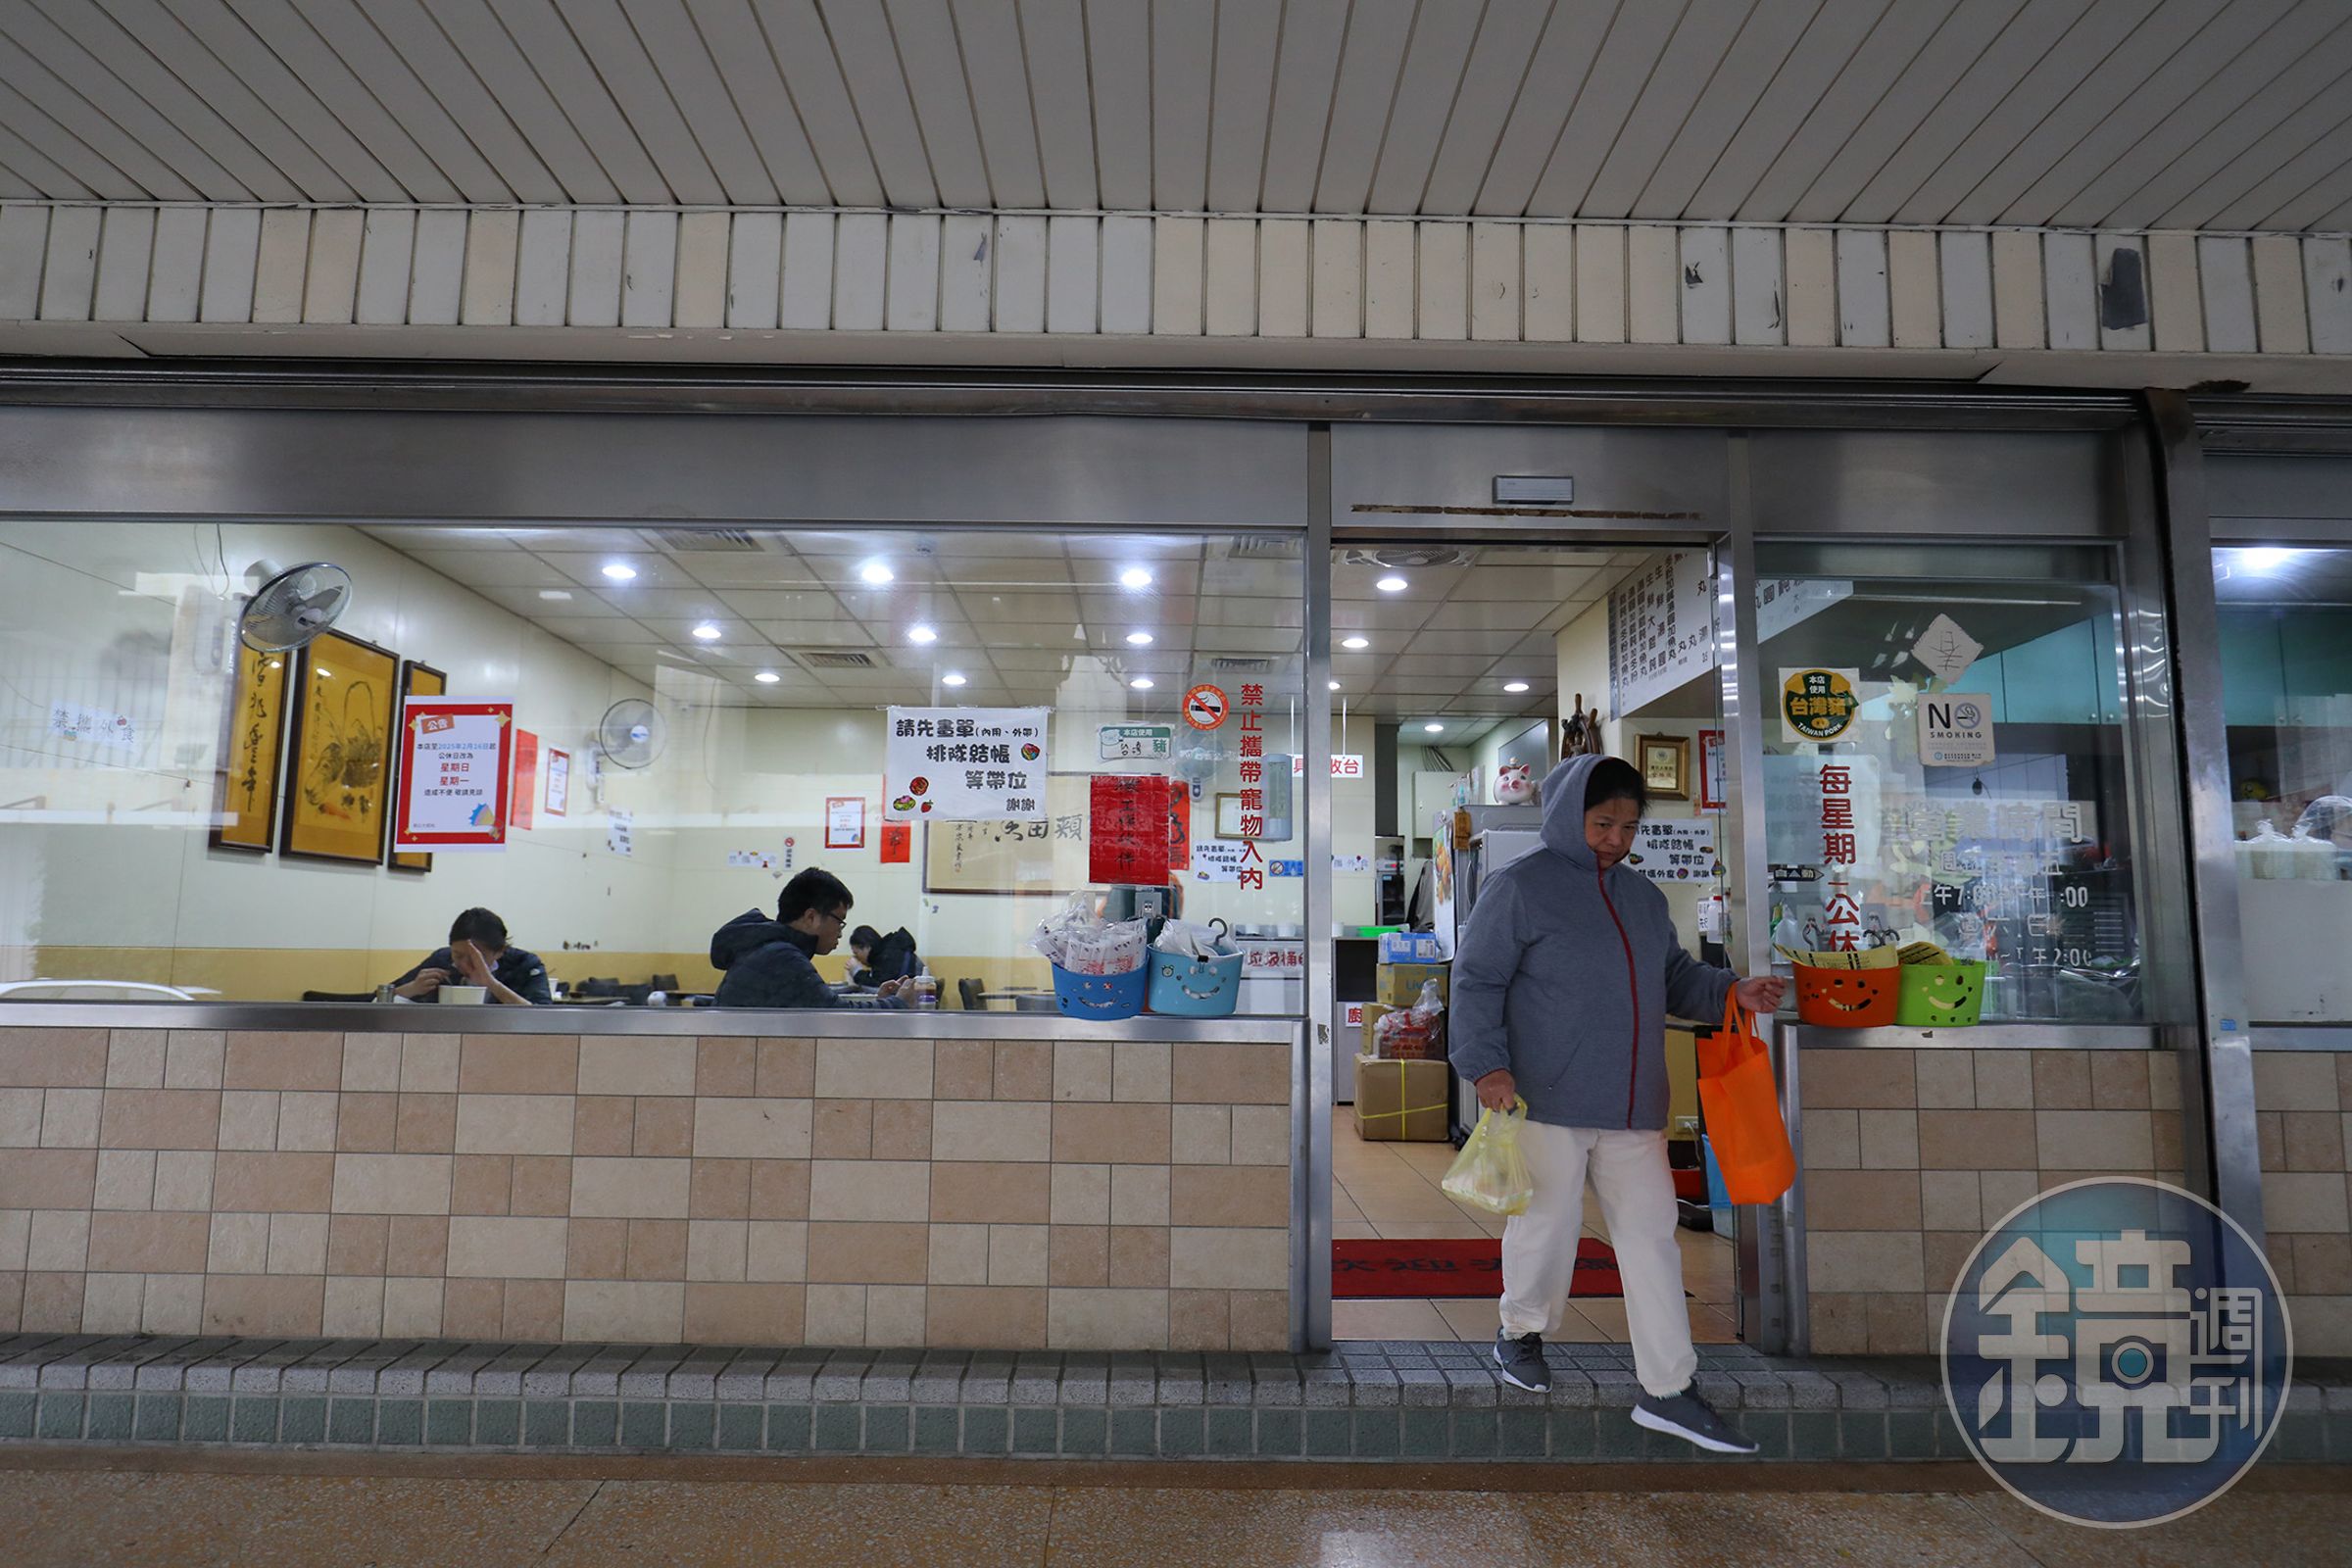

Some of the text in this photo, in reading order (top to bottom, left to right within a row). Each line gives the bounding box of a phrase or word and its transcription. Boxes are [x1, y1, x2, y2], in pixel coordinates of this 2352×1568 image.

[1809, 675, 1825, 684] 本店
[1809, 685, 1825, 694] 使用
[1123, 728, 1152, 737] 本店使用
[1797, 722, 1843, 737] TAIWAN PORK
[926, 744, 1010, 763] 排隊結帳
[439, 763, 469, 772] 星期日
[439, 776, 469, 786] 星期一
[1240, 683, 1263, 890] 禁止攜帶寵物入內
[1006, 798, 1035, 811] 謝謝
